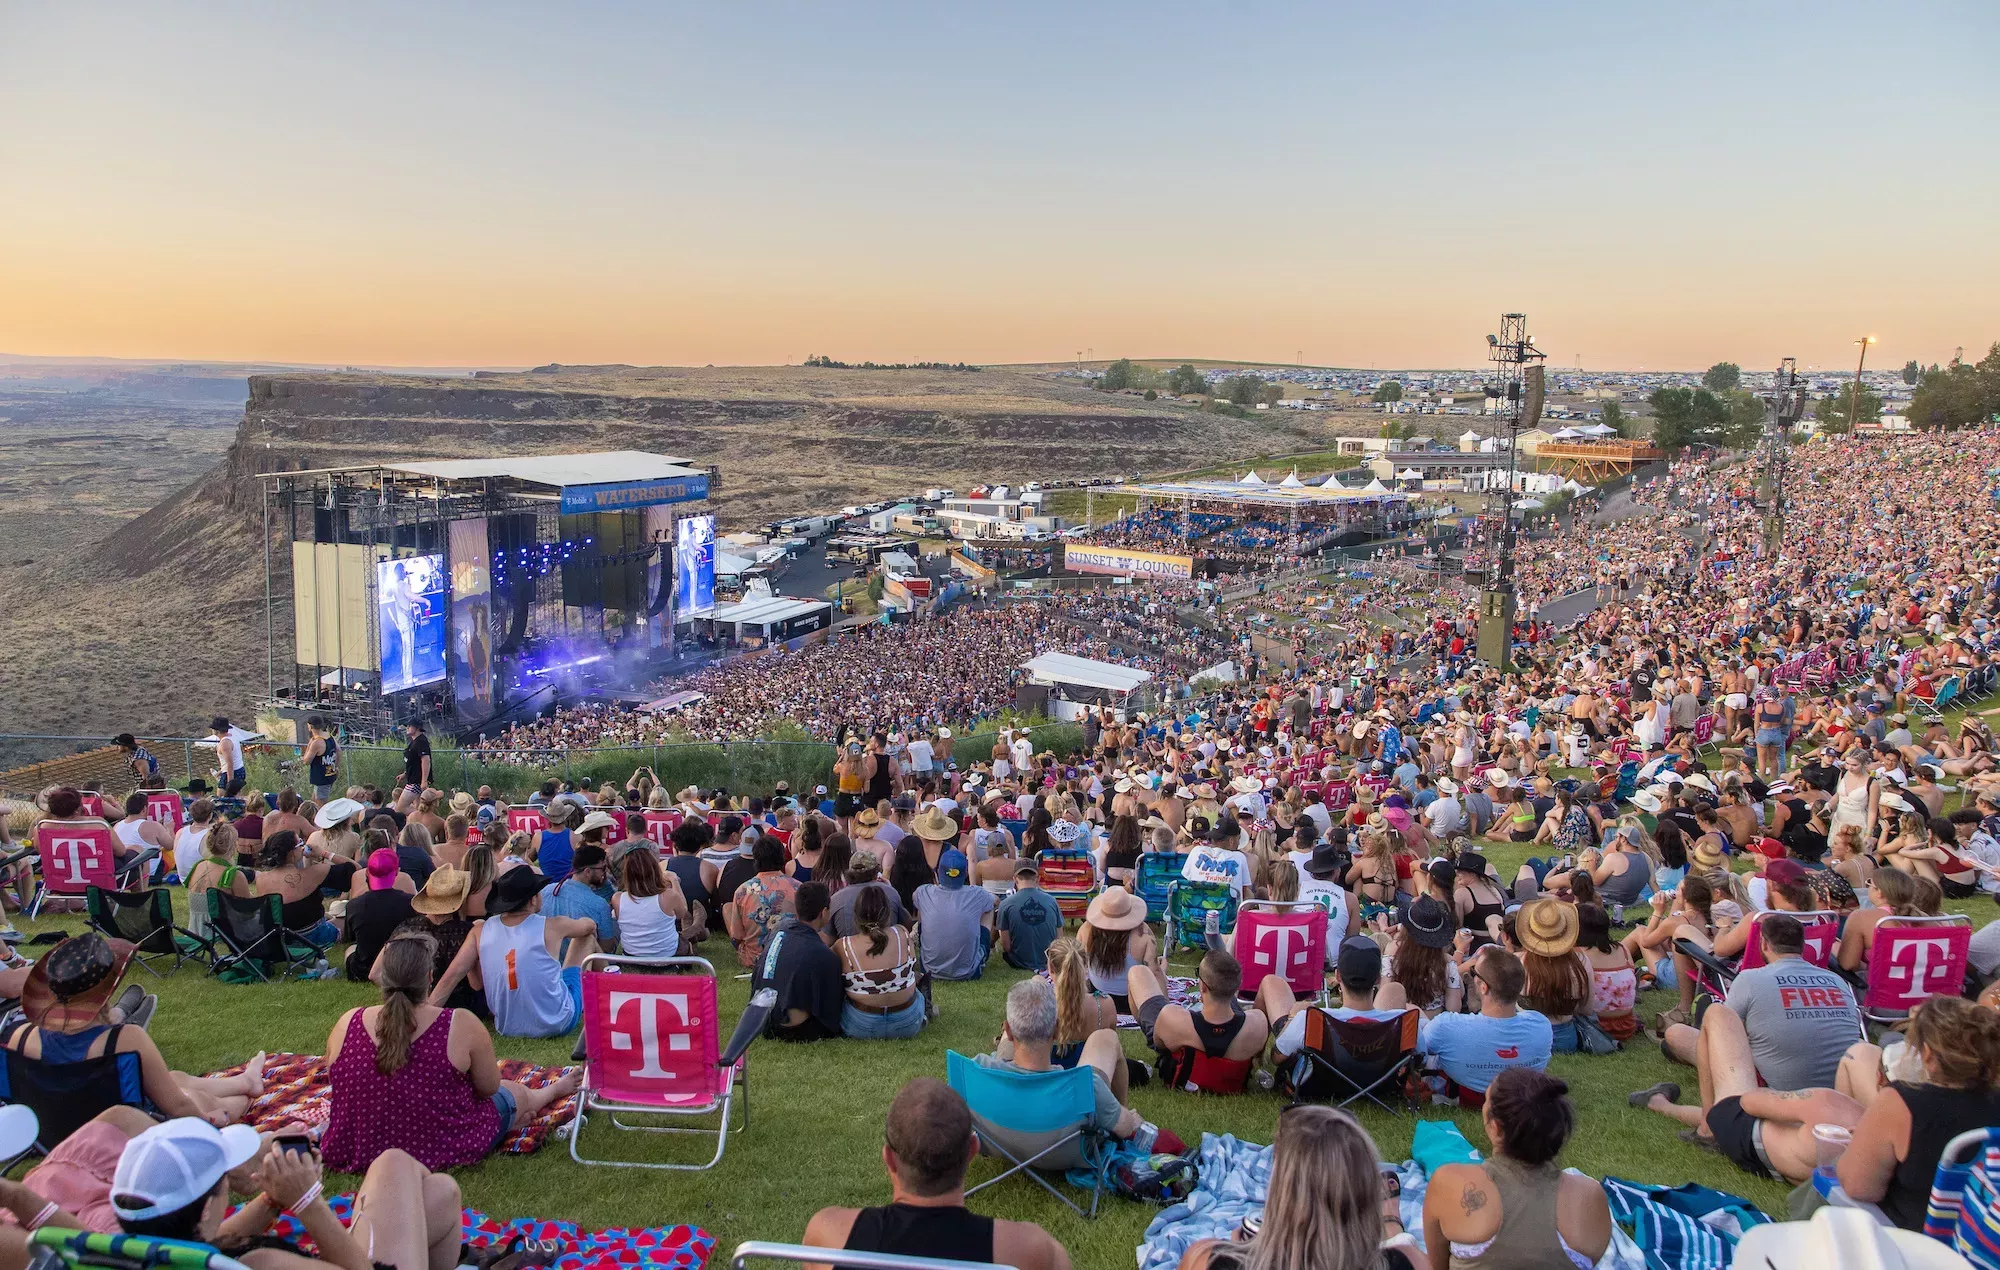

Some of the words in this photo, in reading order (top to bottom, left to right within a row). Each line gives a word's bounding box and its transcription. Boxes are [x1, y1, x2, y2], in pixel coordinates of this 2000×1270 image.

[594, 484, 686, 505] WATERSHED
[1068, 551, 1113, 567] SUNSET
[1135, 559, 1189, 576] LOUNGE
[505, 948, 518, 990] 1
[1775, 975, 1836, 986] BOSTON
[1779, 987, 1847, 1008] FIRE
